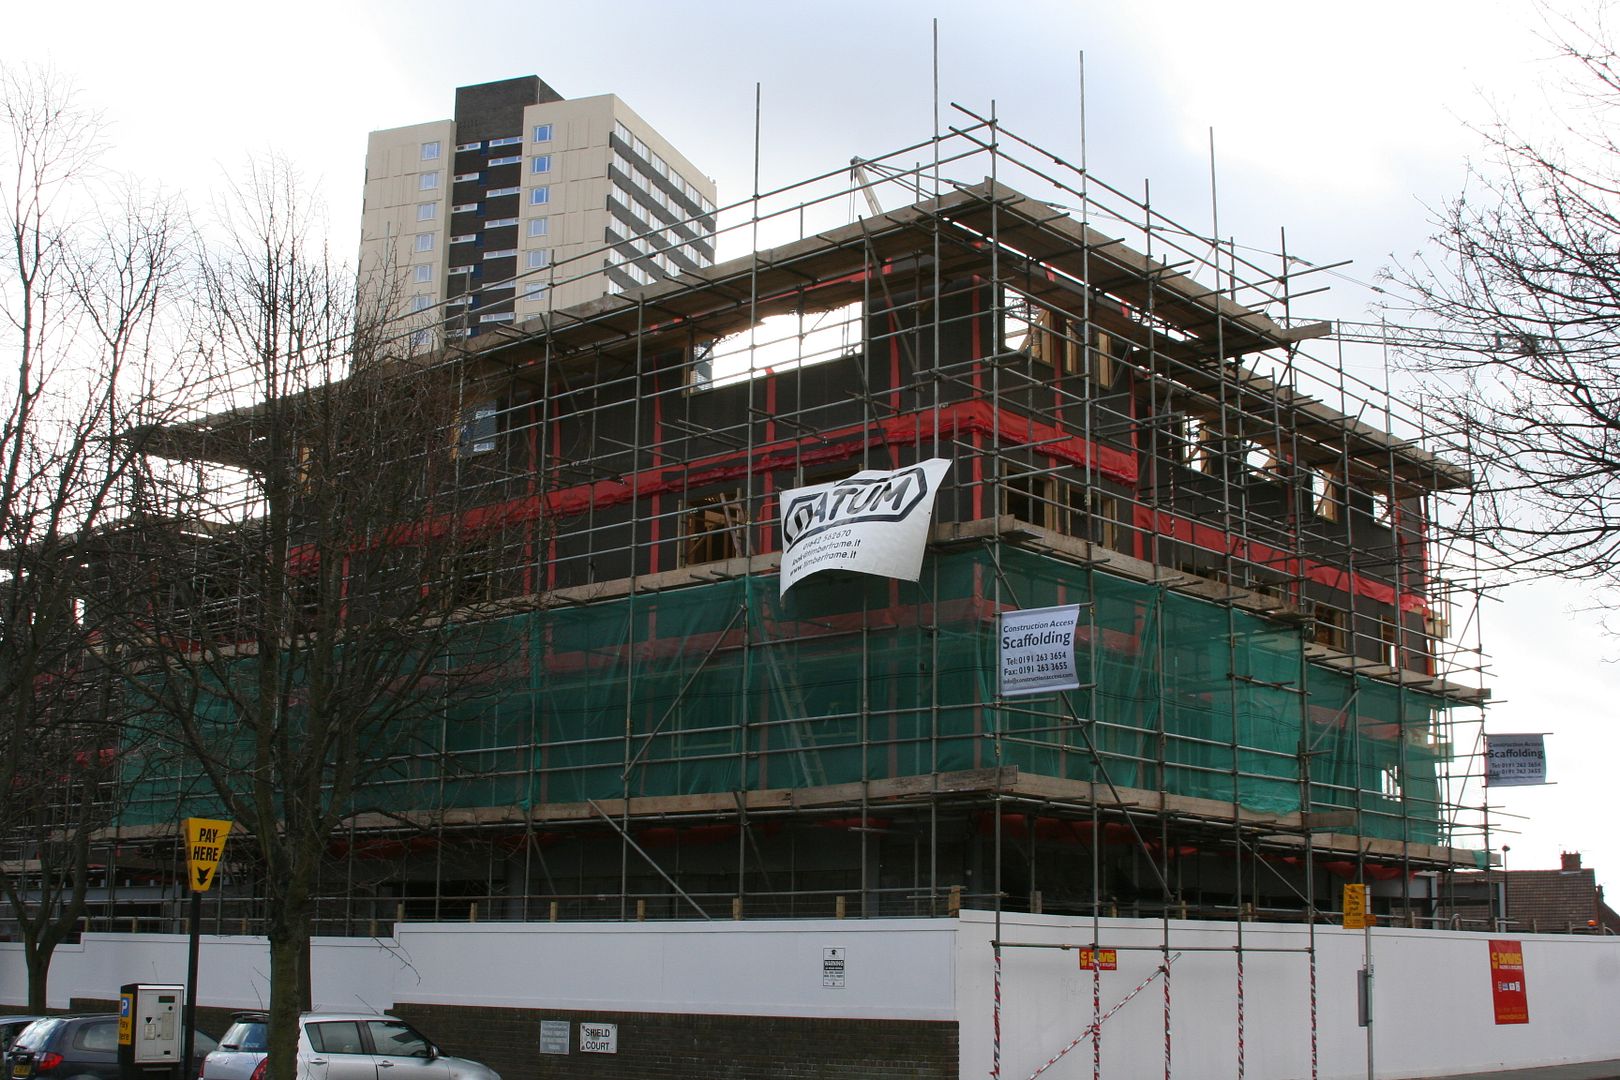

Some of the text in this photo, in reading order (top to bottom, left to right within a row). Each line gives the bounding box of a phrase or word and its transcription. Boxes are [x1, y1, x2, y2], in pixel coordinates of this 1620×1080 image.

[794, 476, 912, 537] DATUM
[1003, 619, 1074, 633] Construction Access
[1002, 630, 1071, 650] Scaffolding
[1018, 655, 1034, 664] 0191
[1036, 653, 1048, 662] 263
[1050, 651, 1067, 660] 3654
[1018, 665, 1034, 675] 0191
[1037, 663, 1049, 672] 263
[1051, 661, 1068, 670] 3655
[1488, 749, 1544, 759] Scaffolding
[199, 828, 218, 843] PAY
[193, 845, 219, 861] HERE
[1089, 952, 1116, 963] DVIS
[585, 1028, 610, 1038] SHIELD
[585, 1040, 610, 1051] COURT
